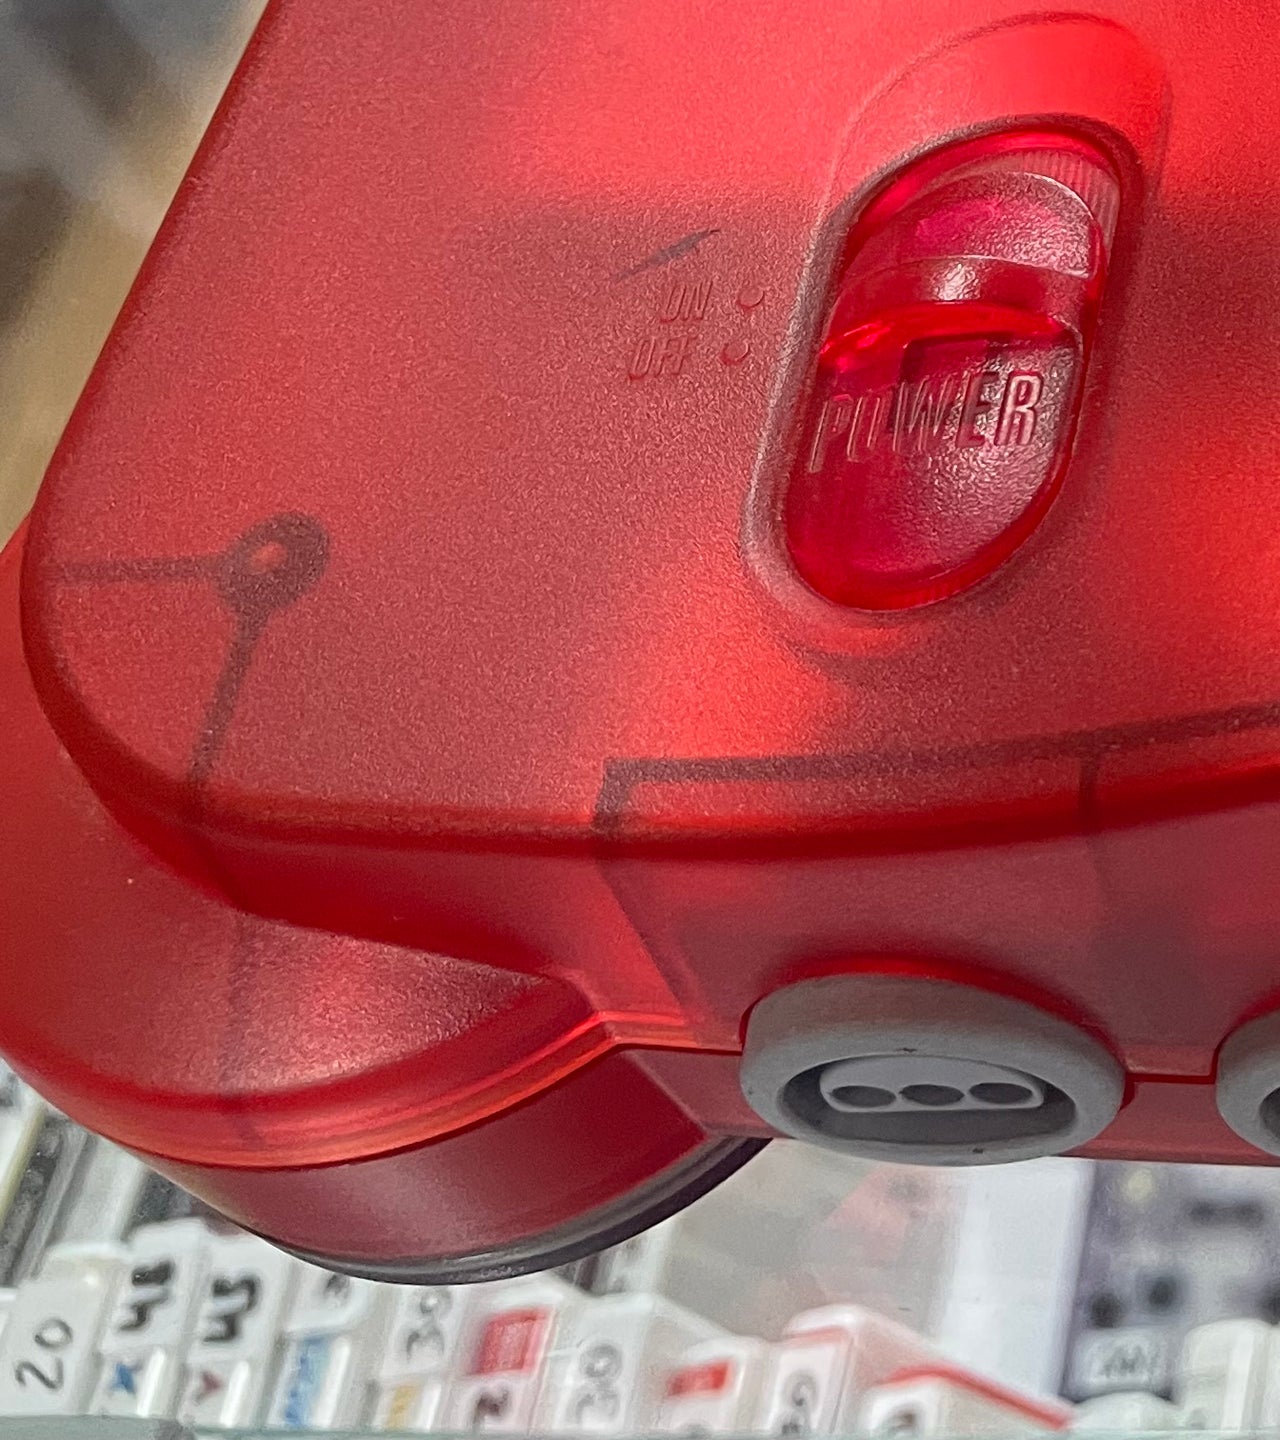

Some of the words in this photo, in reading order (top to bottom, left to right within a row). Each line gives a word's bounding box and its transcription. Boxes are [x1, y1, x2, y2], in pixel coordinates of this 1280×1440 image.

[659, 278, 714, 324] ON
[628, 334, 698, 381] OFF
[808, 369, 1044, 473] POWER
[14, 1318, 73, 1389] 20
